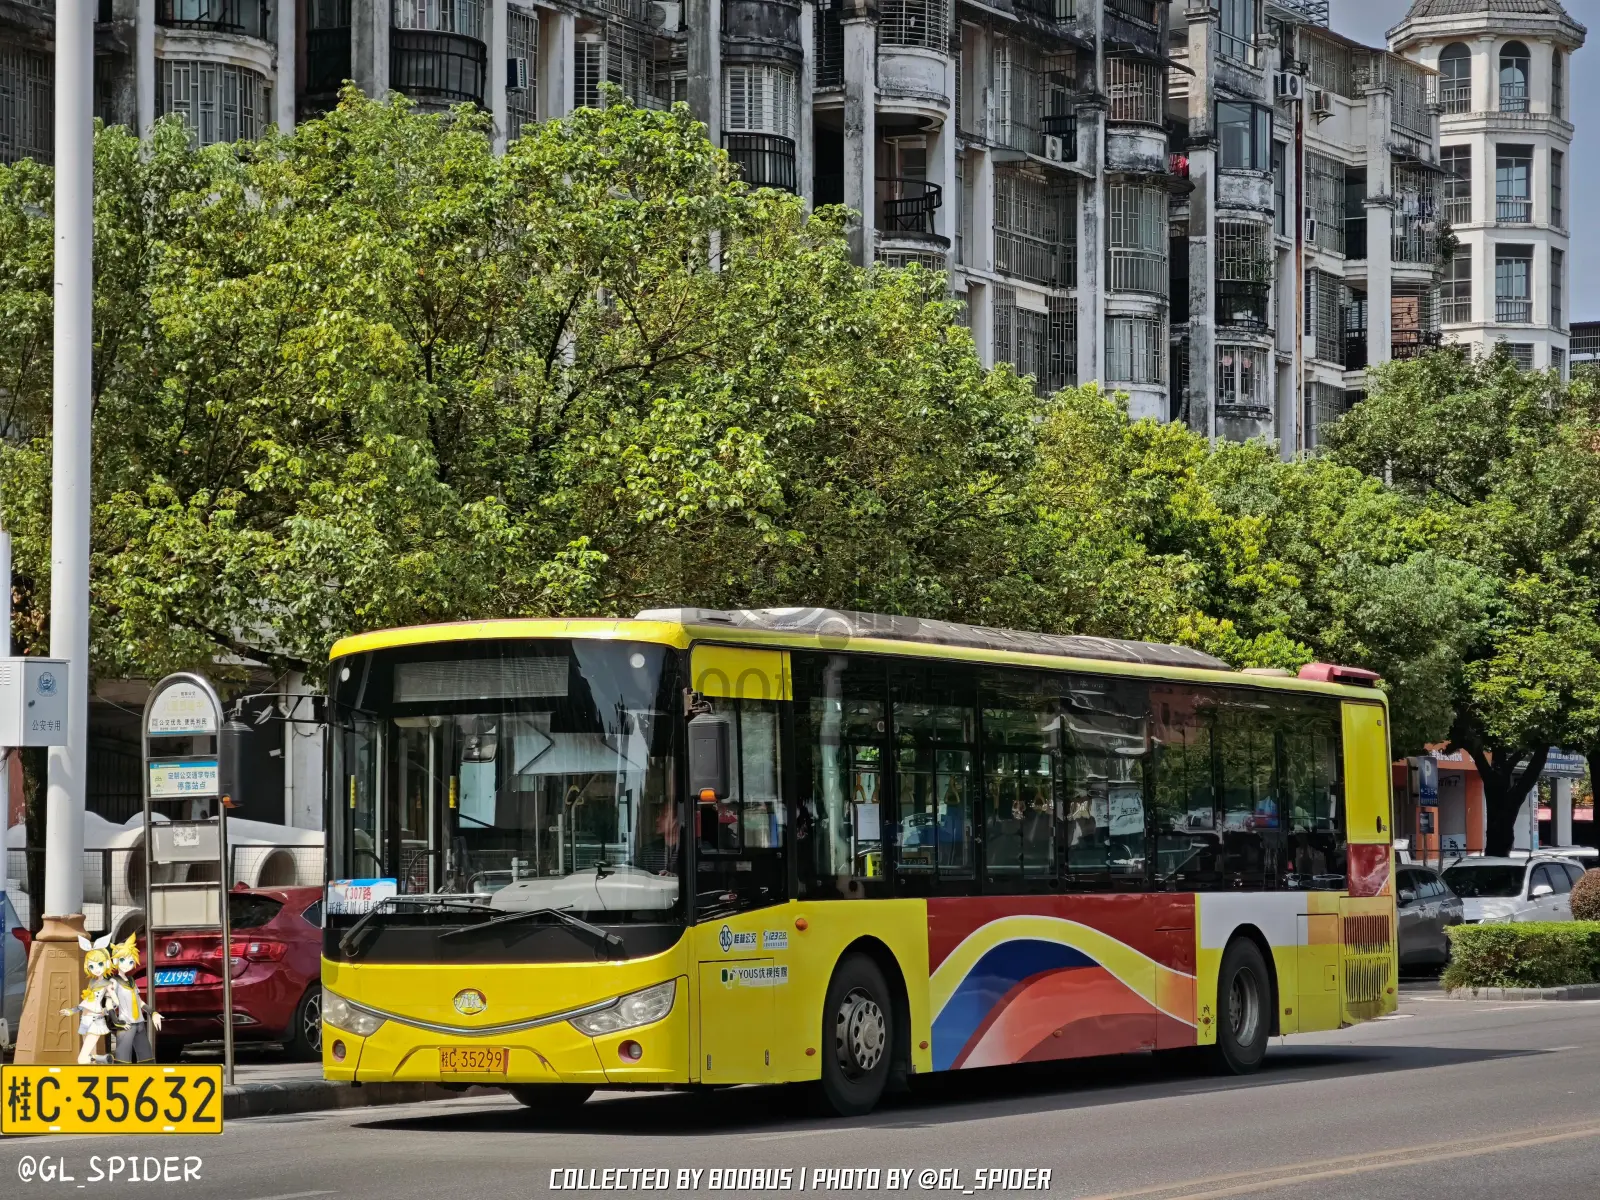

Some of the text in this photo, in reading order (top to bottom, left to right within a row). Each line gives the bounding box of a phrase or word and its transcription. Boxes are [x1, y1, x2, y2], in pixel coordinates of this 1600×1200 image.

[32, 719, 61, 731] 公安专用
[177, 781, 206, 791] 停靠站点
